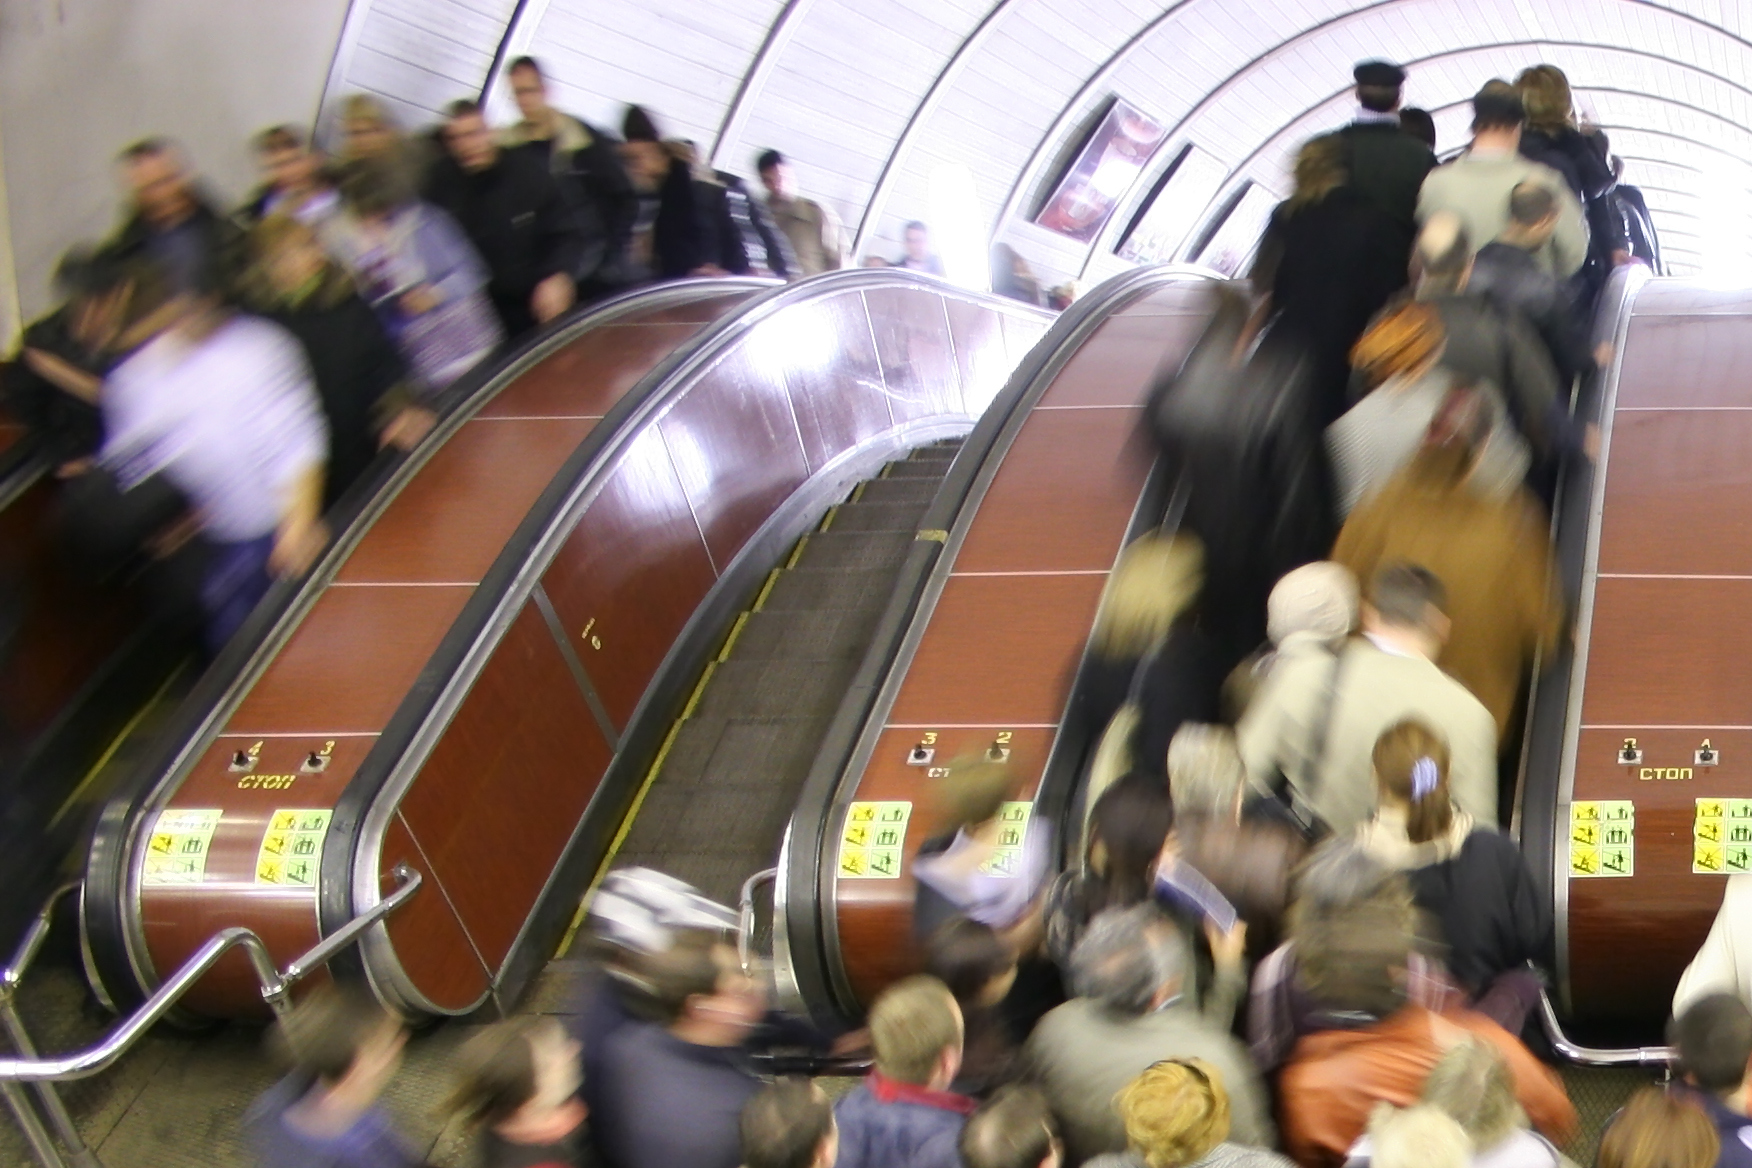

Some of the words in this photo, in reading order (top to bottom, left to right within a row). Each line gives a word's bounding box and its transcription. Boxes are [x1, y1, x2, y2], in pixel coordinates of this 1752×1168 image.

[921, 732, 938, 745] 3
[996, 731, 1012, 744] 2
[248, 741, 264, 755] 4
[320, 741, 335, 755] 3
[928, 768, 951, 778] СТ
[1640, 767, 1693, 780] СТОП
[238, 774, 297, 790] СТОП
